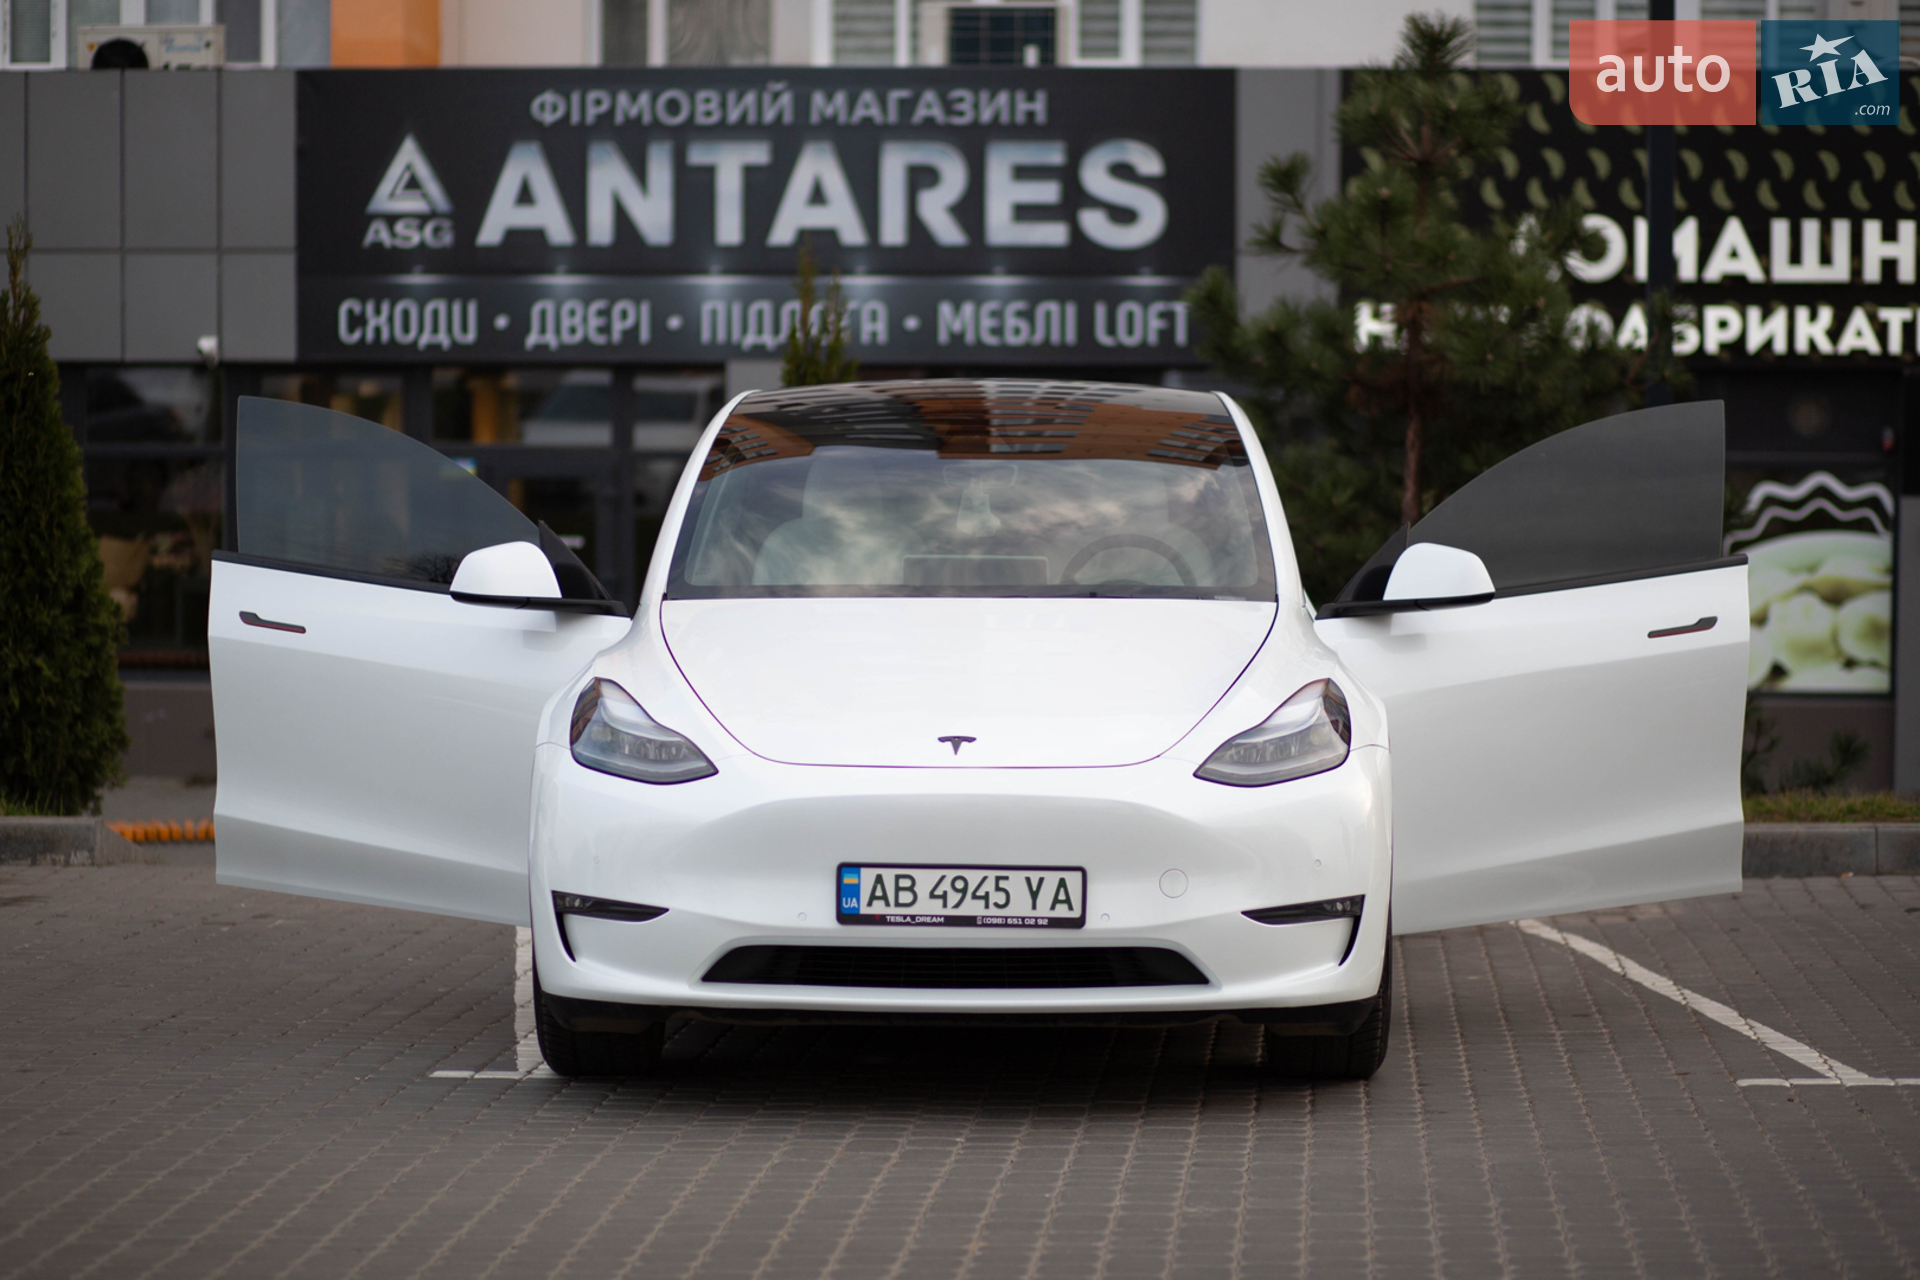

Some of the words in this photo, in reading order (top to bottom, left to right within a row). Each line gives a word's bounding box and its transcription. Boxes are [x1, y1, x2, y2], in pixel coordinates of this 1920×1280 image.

[530, 82, 794, 126] ФІРМОВИЙ
[809, 90, 1048, 125] МАГАЗИН
[475, 138, 1168, 250] ANTARES
[362, 219, 455, 248] ASG
[337, 299, 477, 350] СХОДИ
[525, 299, 650, 350] ДВЕРІ
[937, 301, 1077, 346] МЕБЛІ
[1094, 301, 1189, 346] LOFT
[843, 897, 858, 908] UA
[866, 873, 918, 908] AB
[929, 874, 1011, 909] 4945
[885, 915, 944, 924] TESLA_DREAM
